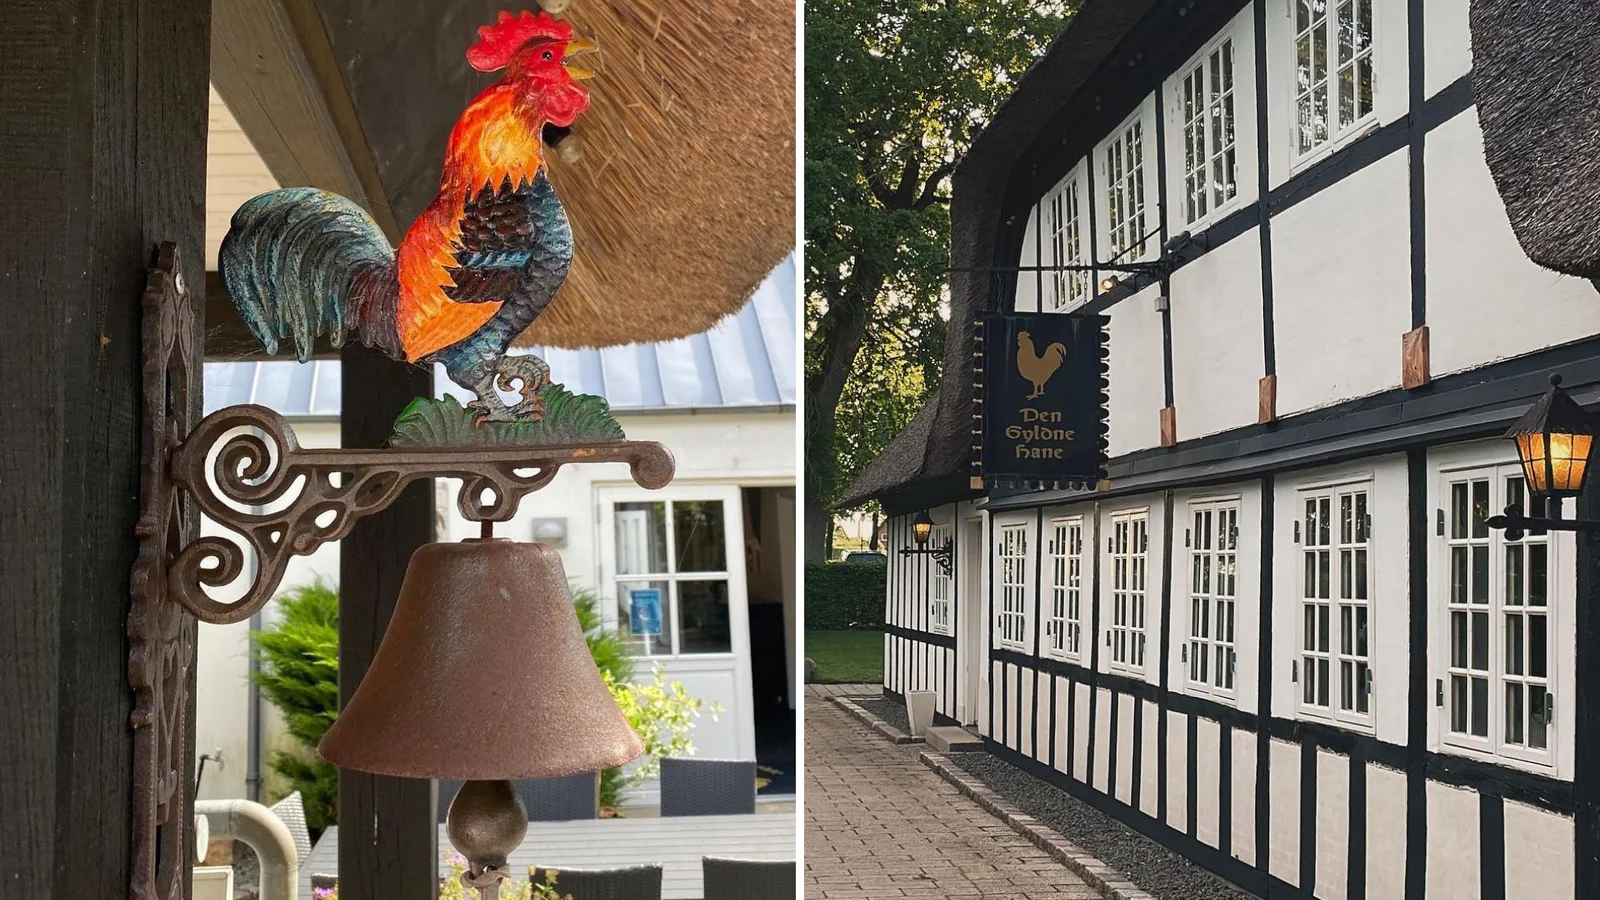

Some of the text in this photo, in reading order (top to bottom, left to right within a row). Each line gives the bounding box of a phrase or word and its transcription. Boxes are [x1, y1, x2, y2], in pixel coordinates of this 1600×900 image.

[1019, 408, 1062, 422] Den
[1005, 425, 1075, 443] Gyldne
[1015, 444, 1064, 459] Hane
